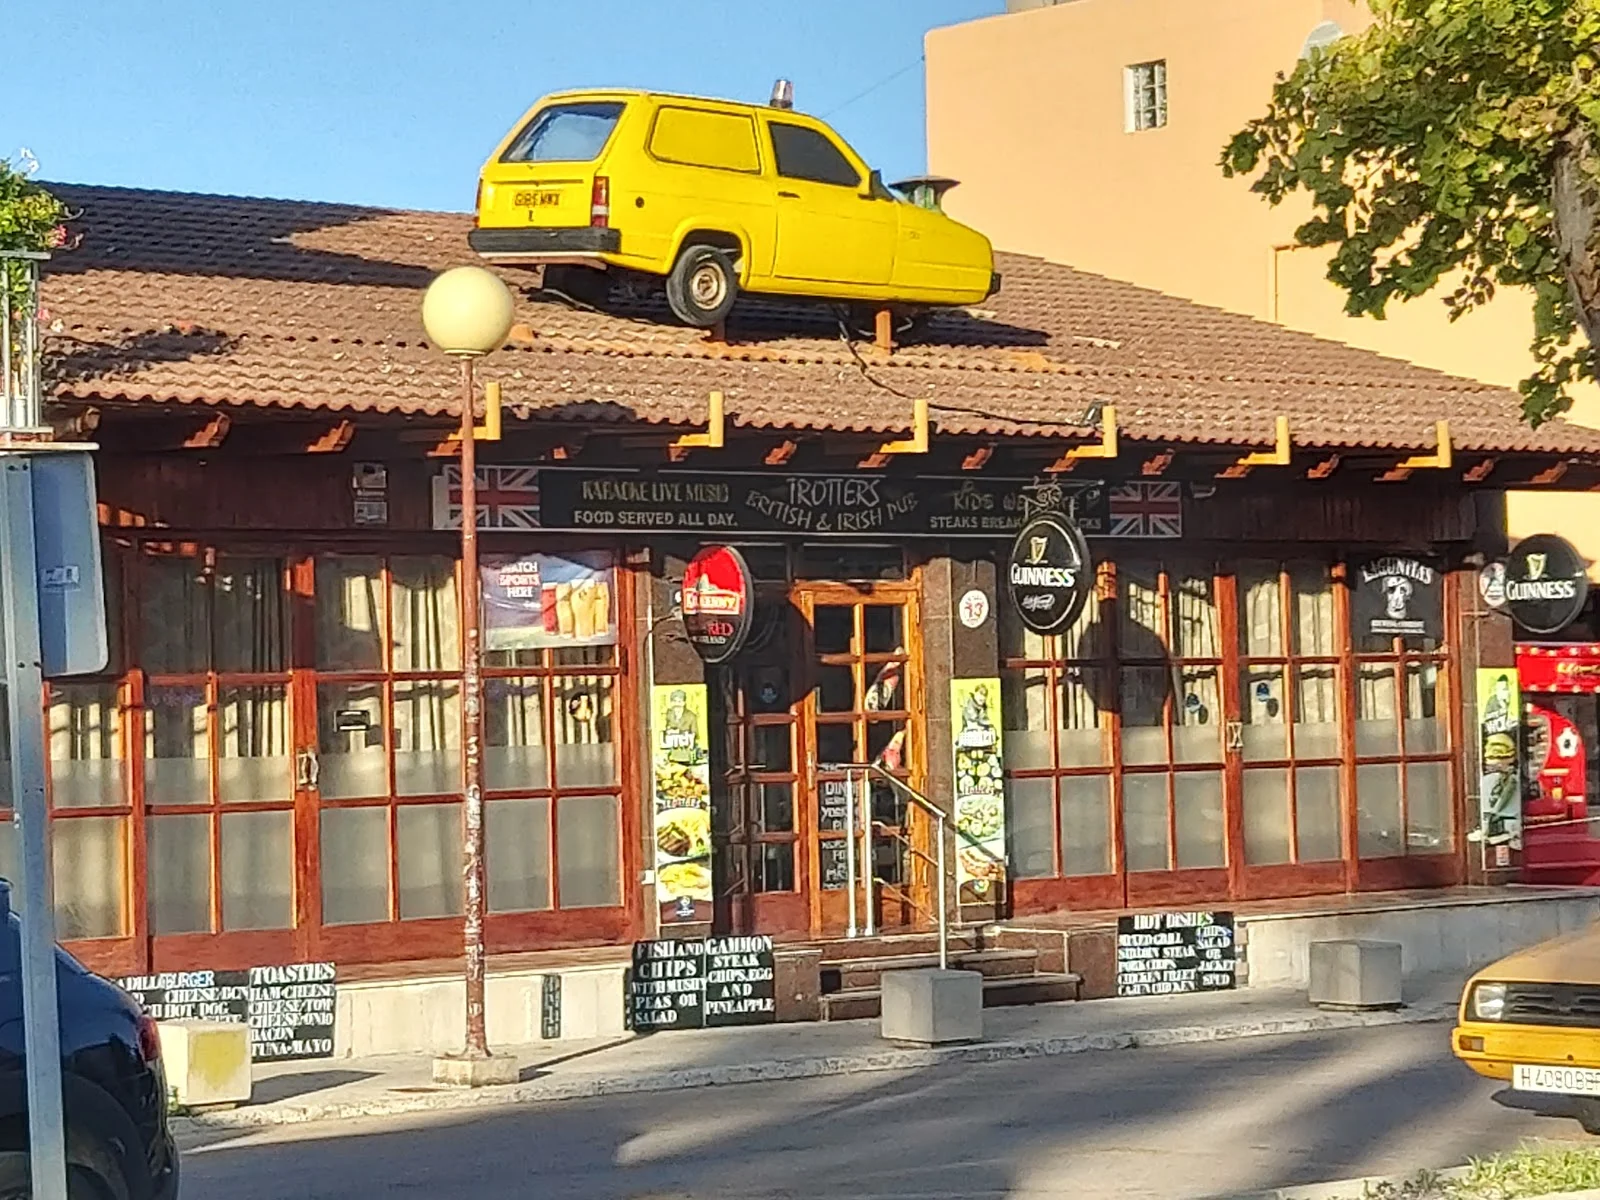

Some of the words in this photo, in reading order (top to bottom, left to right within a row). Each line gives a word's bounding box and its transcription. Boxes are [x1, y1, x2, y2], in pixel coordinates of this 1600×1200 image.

[653, 481, 682, 502] LIVE
[787, 478, 881, 507] TROTTERS
[953, 491, 994, 511] KIDS
[574, 510, 614, 524] FOOD
[618, 510, 673, 525] SERVED
[678, 511, 705, 526] ALL
[745, 490, 812, 529] BRITISH
[816, 513, 831, 531] &
[837, 508, 882, 531] IRISH
[887, 493, 918, 520] PUB
[930, 516, 978, 529] STEAKS
[1011, 563, 1076, 587] GUINNESS
[1506, 580, 1576, 600] GUINNESS
[1134, 914, 1162, 930] HOT
[1166, 911, 1214, 929] DISHES
[637, 941, 675, 958] FISH
[676, 942, 703, 956] AND
[706, 935, 773, 954] GAMMON
[1162, 945, 1197, 959] STEAK
[1197, 937, 1231, 950] SALAD
[714, 953, 760, 968] STEAK
[1206, 948, 1223, 960] OR
[251, 962, 336, 984] TOASTIES
[639, 959, 697, 978] CHIPS
[1197, 960, 1235, 972] JACKET
[632, 980, 665, 994] WITH
[666, 977, 708, 993] MUSHY
[1202, 973, 1231, 986] SPUD
[721, 983, 753, 998] AND
[164, 1003, 195, 1018] HOT
[199, 1001, 229, 1017] DOG
[635, 995, 672, 1009] PEAS
[679, 993, 698, 1007] OR
[706, 997, 775, 1015] PINEAPPLE
[636, 1009, 678, 1025] SALAD
[251, 1026, 294, 1041] BACON
